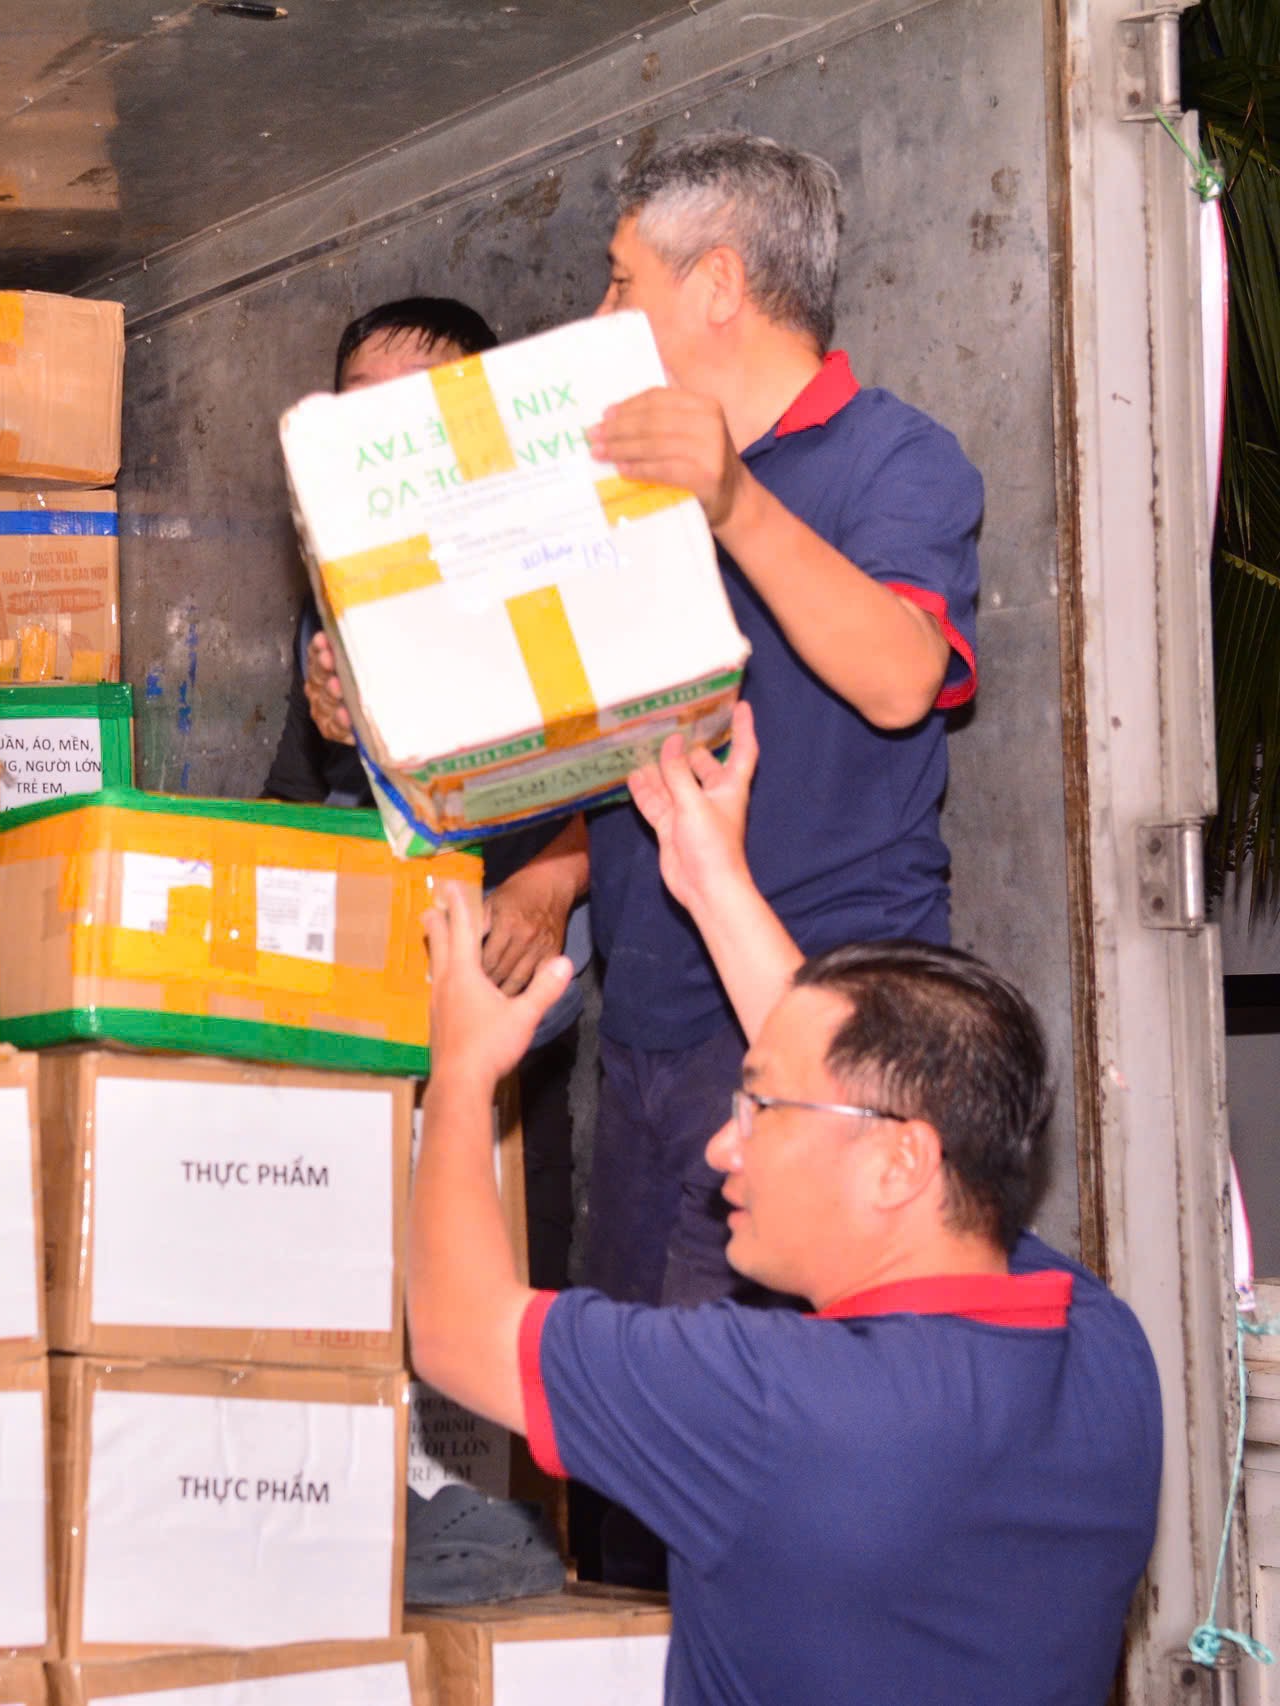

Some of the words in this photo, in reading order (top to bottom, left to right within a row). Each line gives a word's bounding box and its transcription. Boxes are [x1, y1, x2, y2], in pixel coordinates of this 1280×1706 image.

[513, 383, 577, 420] XIN
[356, 431, 423, 472] TAY
[33, 736, 55, 752] ÁO,
[59, 736, 94, 752] MỀN,
[26, 758, 71, 772] NGƯỜI
[17, 777, 38, 793] TRẺ
[42, 783, 67, 797] EM,
[181, 1161, 250, 1188] THỰC
[258, 1156, 330, 1187] PHẨM
[178, 1475, 250, 1504] THỰC
[256, 1471, 331, 1503] PHẨM
